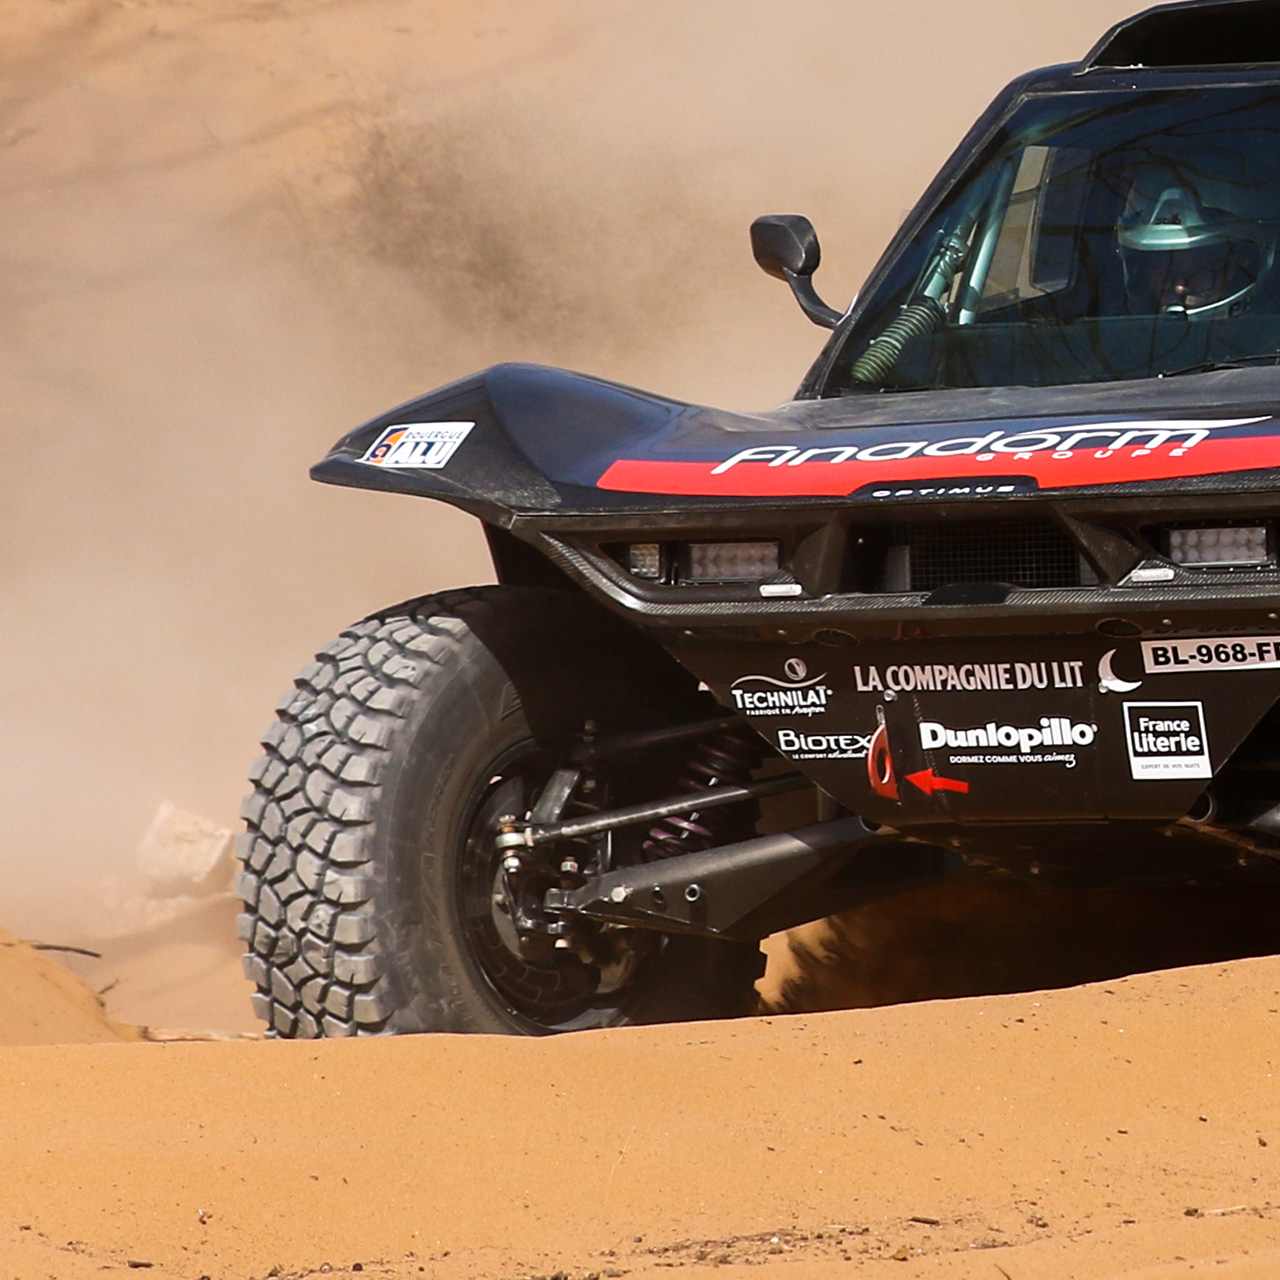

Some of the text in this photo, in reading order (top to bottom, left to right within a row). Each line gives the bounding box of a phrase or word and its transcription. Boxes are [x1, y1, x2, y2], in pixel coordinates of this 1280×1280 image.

[405, 431, 464, 440] ROUERGUE
[386, 441, 456, 464] ALU
[975, 448, 1189, 461] GROUPE
[872, 485, 1016, 498] OPTIMUS
[853, 661, 1084, 692] LA COMPAGNIE DU LIT
[731, 686, 827, 709] TECHNILAT
[791, 706, 826, 718] Aveyron
[1138, 717, 1191, 732] France
[919, 718, 1095, 754] Dunlopillo
[1133, 732, 1201, 753] literie
[949, 752, 1076, 769] DORMEZ COMME VOUS aimez
